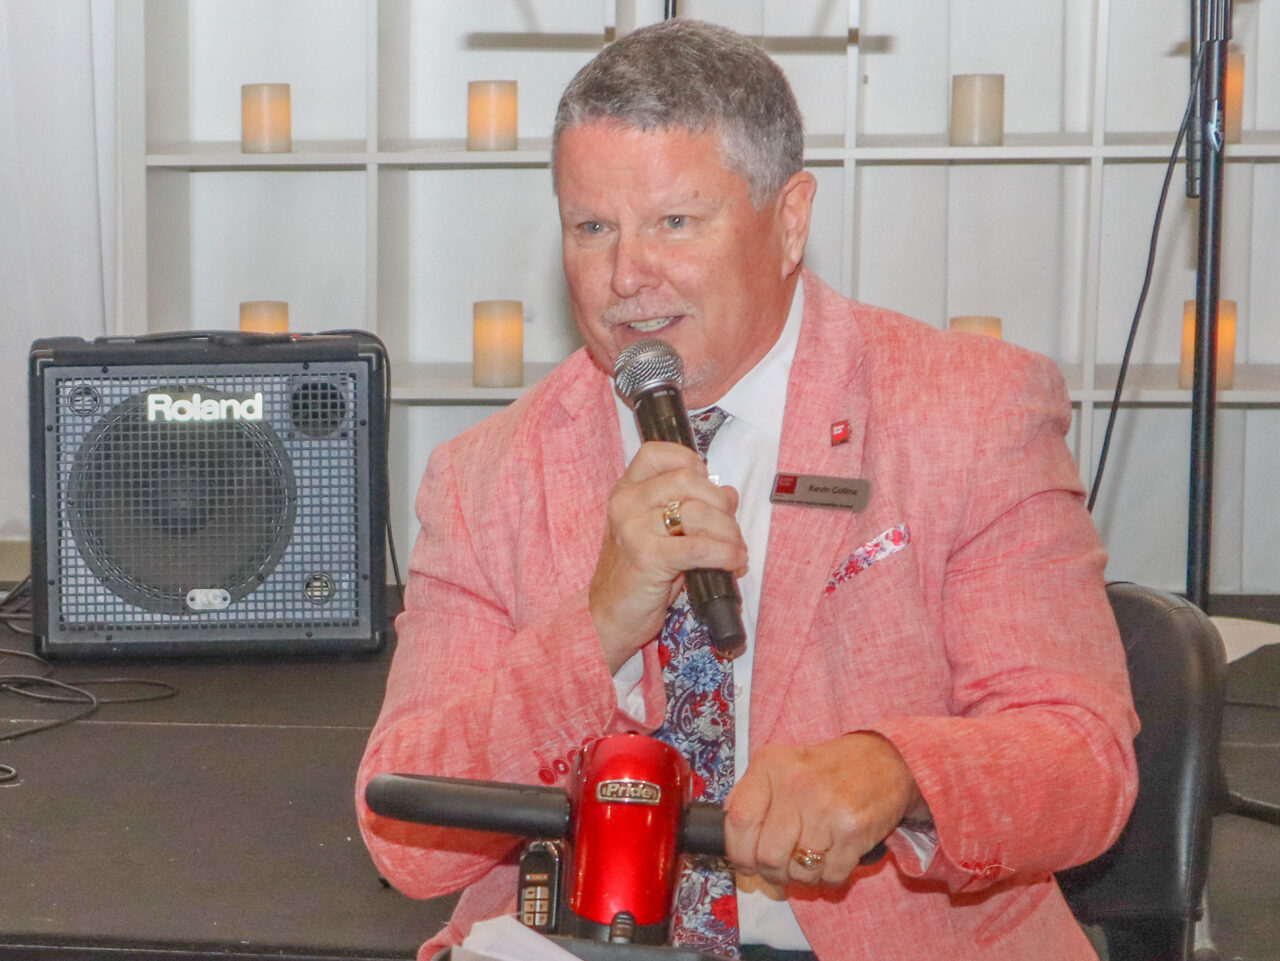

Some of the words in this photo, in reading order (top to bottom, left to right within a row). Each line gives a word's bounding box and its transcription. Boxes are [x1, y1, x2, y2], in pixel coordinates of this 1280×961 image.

[147, 391, 263, 421] Roland
[808, 484, 830, 493] Kevin
[606, 783, 652, 798] Pride
